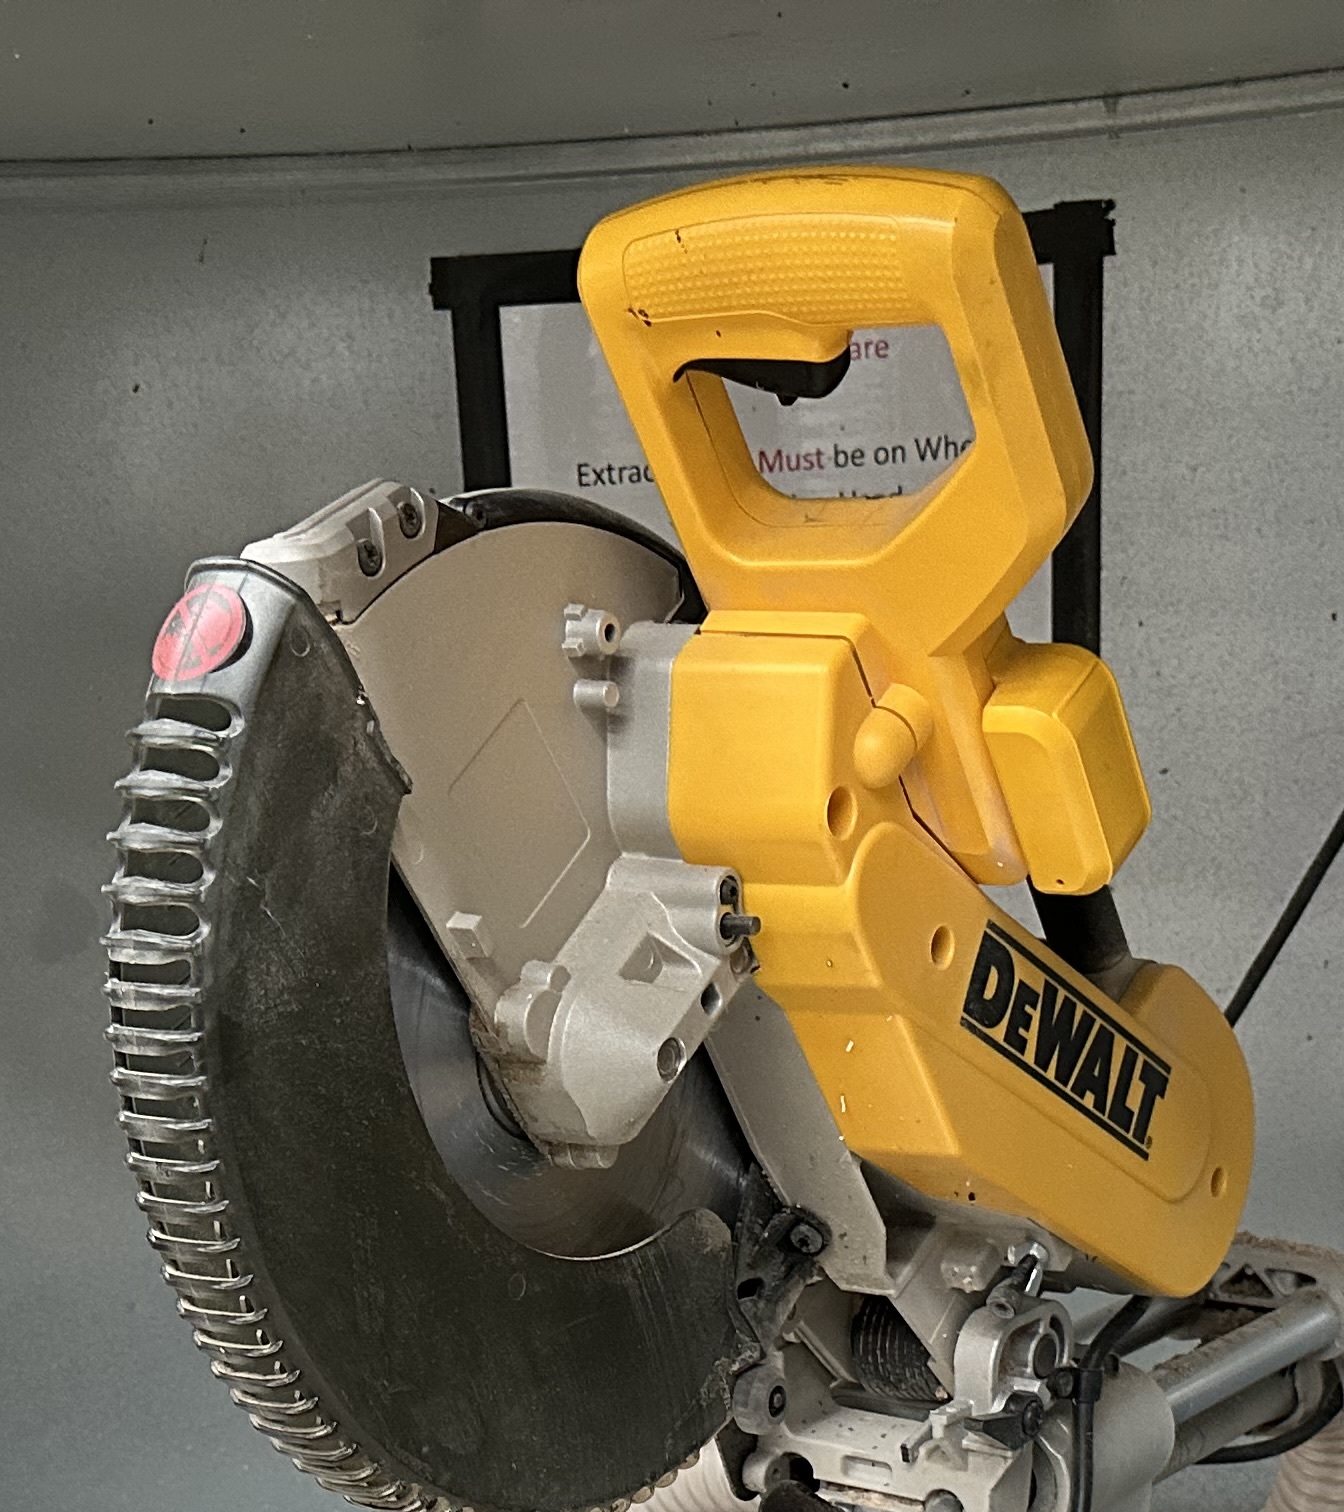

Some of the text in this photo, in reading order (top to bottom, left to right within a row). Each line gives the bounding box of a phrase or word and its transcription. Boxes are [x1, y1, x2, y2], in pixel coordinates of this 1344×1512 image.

[758, 448, 825, 474] Must
[833, 443, 865, 468] be
[874, 444, 905, 466] on
